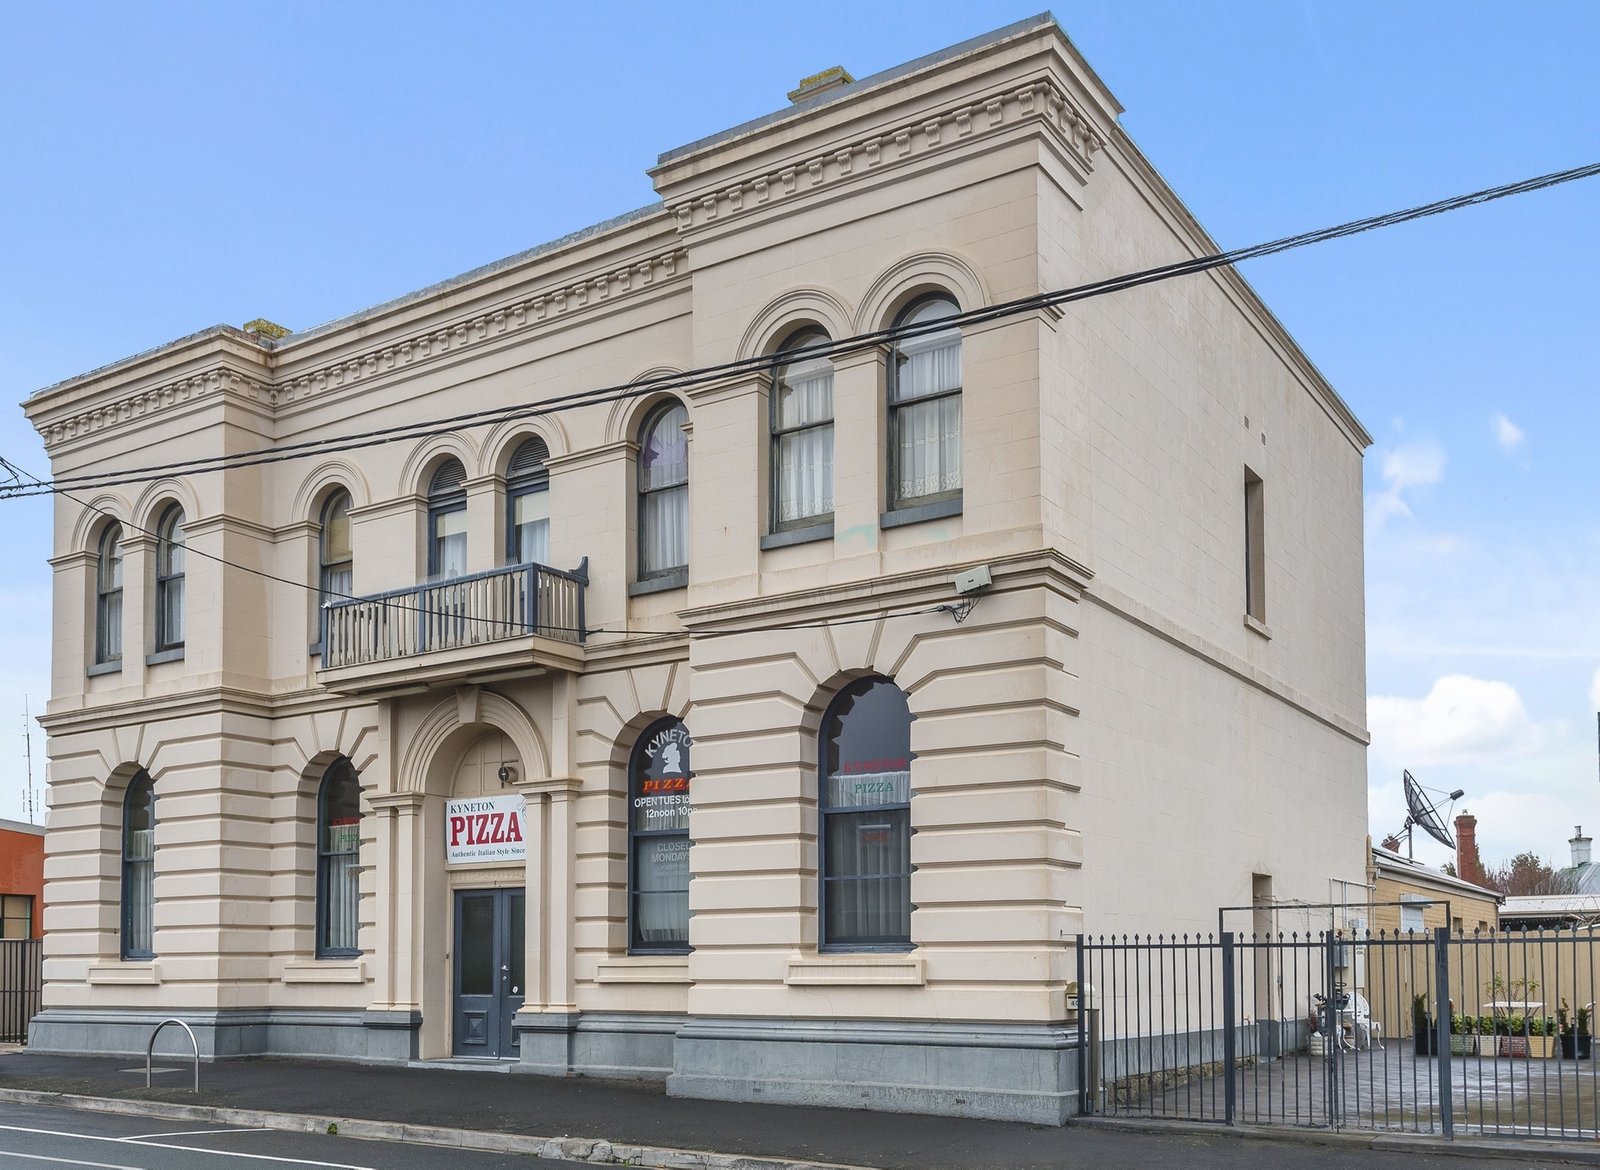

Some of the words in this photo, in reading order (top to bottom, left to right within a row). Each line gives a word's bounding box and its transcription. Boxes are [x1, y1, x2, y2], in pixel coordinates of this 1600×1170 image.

[855, 782, 894, 793] PIZZA
[634, 796, 658, 808] OPEN
[658, 795, 682, 806] TUES
[450, 801, 495, 814] KYNETON
[645, 809, 676, 818] 12noon
[450, 812, 523, 846] PIZZA
[496, 847, 510, 857] Style
[657, 841, 692, 852] CLOSED
